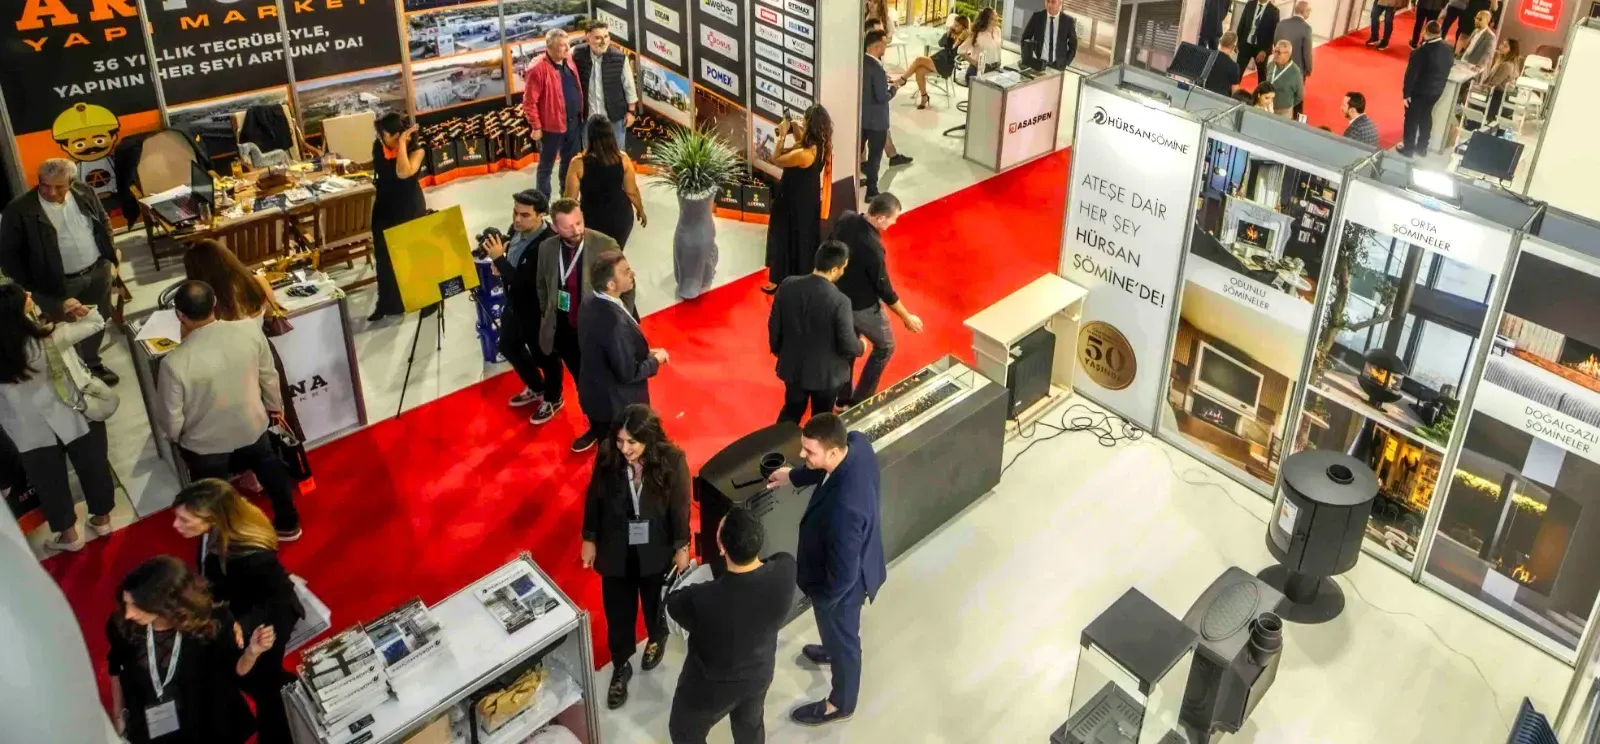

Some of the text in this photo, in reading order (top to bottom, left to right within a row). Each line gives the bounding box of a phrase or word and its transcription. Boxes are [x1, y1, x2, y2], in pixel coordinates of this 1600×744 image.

[708, 0, 734, 15] weber
[53, 73, 145, 98] YAPININ
[151, 64, 195, 80] HER
[200, 56, 243, 74] ŞEYİ
[335, 36, 364, 50] DA!
[93, 58, 119, 73] 36
[706, 65, 733, 88] POMEX
[1081, 173, 1167, 220] ATEŞE DAİR
[1079, 200, 1141, 237] HER ŞEY
[1410, 217, 1437, 234] ORTA
[1075, 226, 1141, 268] HÜRSAN
[1073, 253, 1165, 308] ŞÖMİNE'DE!
[1230, 277, 1266, 298] ODUNLU
[1085, 335, 1126, 372] 50
[1525, 406, 1599, 444] DOĞALGAZLI
